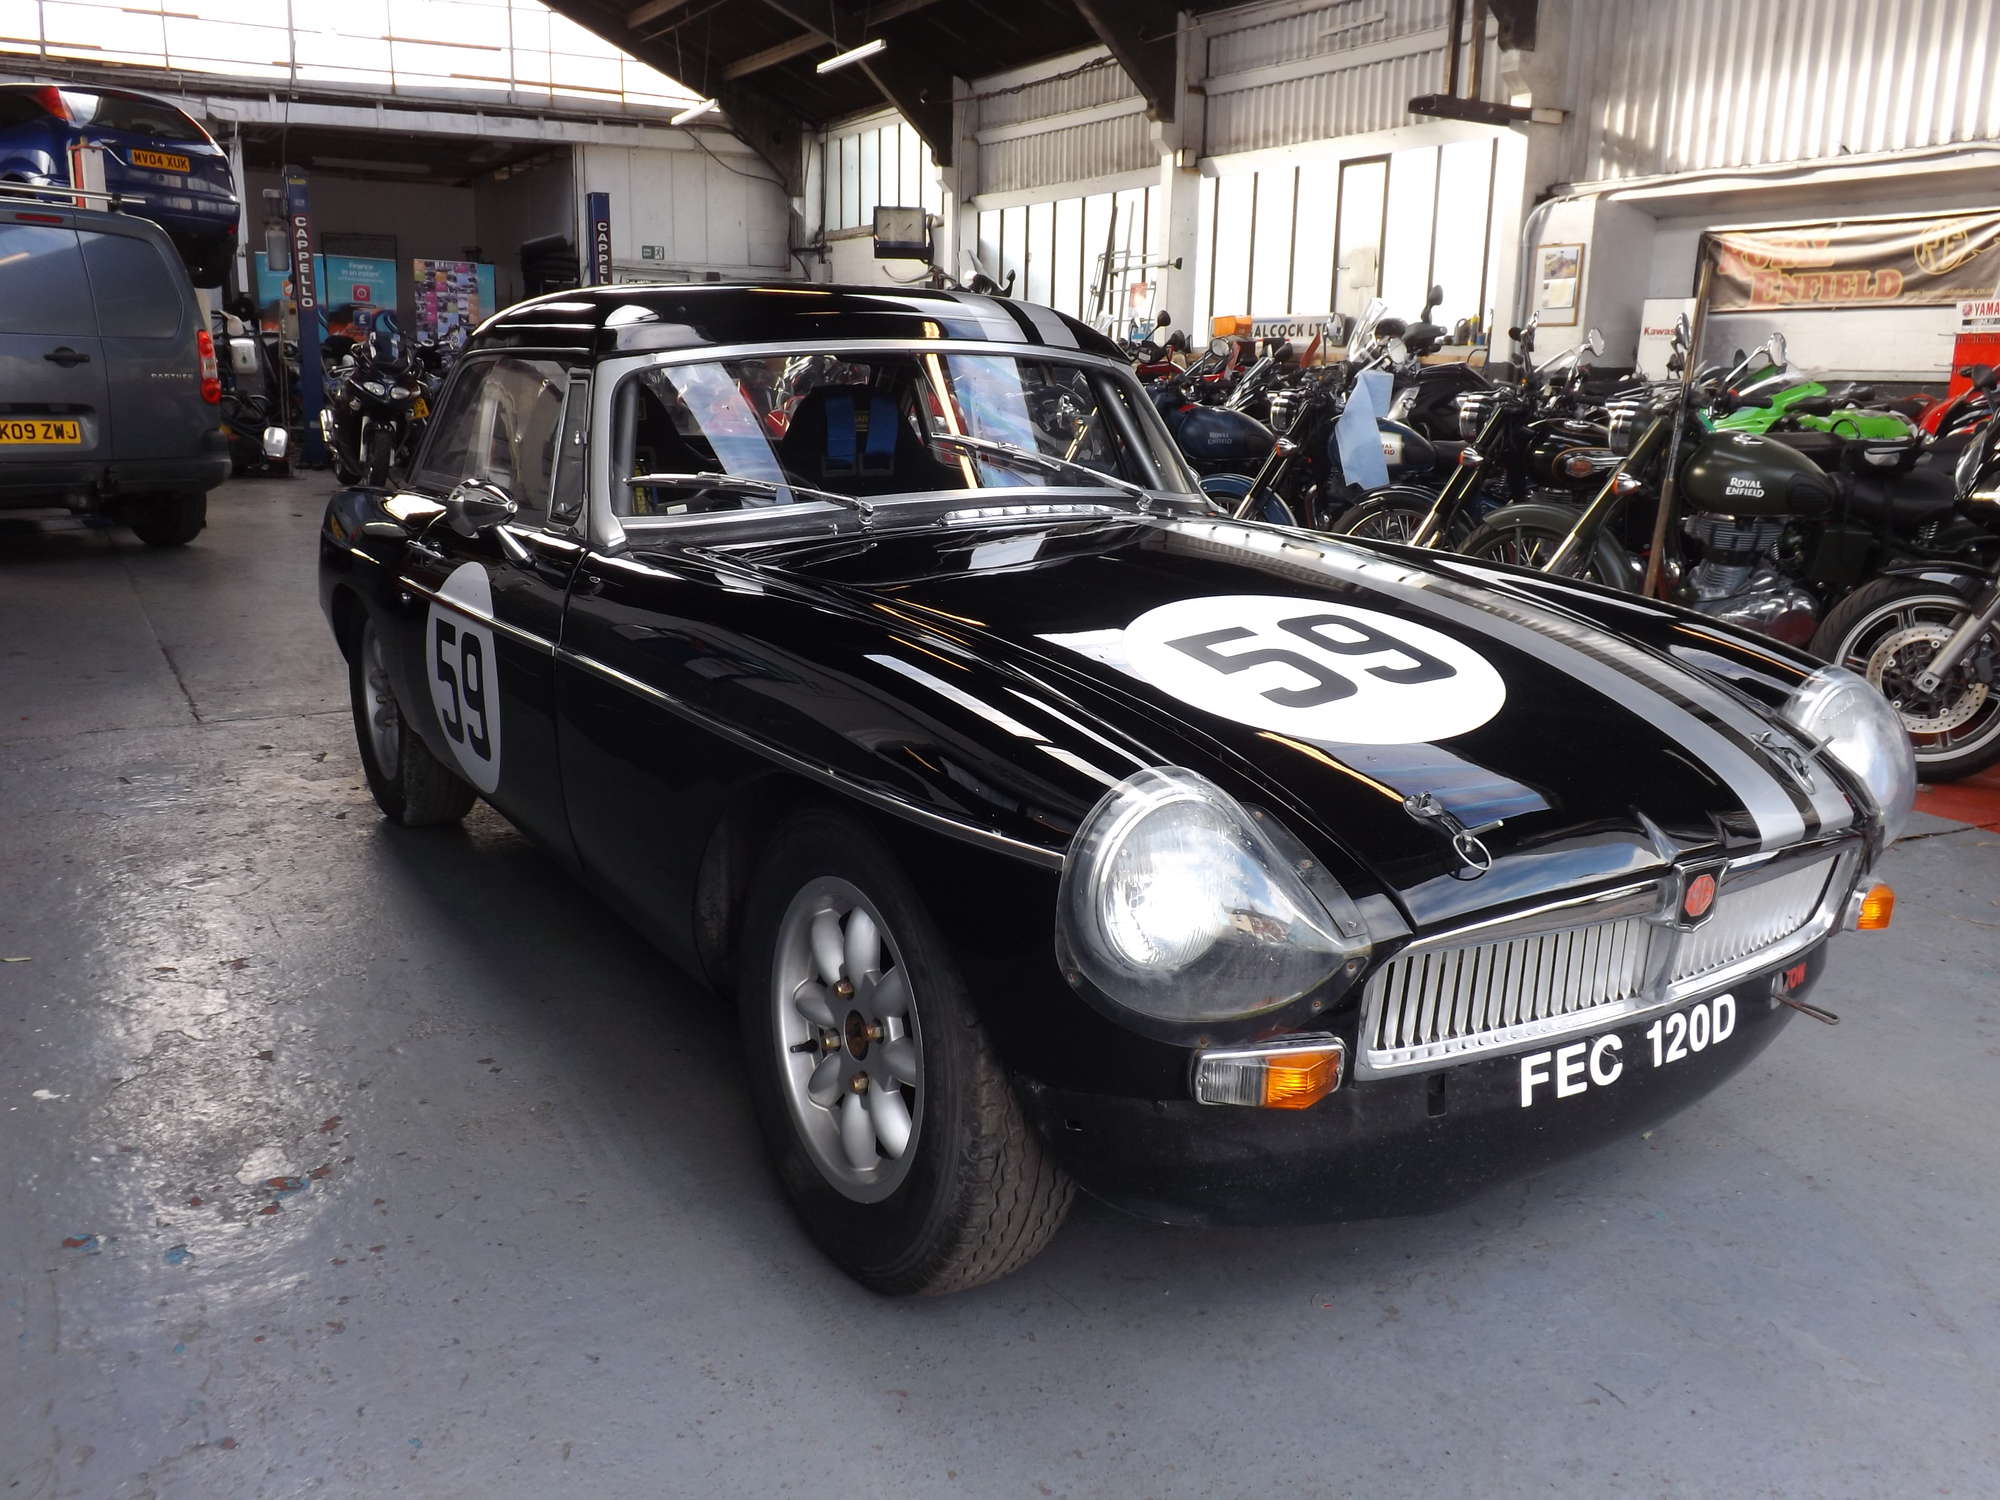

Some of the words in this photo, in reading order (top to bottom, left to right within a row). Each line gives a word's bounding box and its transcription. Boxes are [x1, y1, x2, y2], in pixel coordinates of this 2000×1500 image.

[166, 156, 188, 169] XUK
[294, 216, 314, 308] CAPPELLO
[597, 222, 609, 285] CAPPEL
[1750, 269, 1904, 304] ENFIELD
[1253, 323, 1304, 338] ALCOCK
[1643, 327, 1677, 336] Kawas
[0, 423, 36, 440] K09
[40, 423, 77, 440] ZWJ
[1725, 486, 1765, 498] ENFIELD
[1730, 477, 1761, 488] ROYAL
[1163, 613, 1458, 708] 59
[435, 617, 492, 762] 59
[1520, 1033, 1624, 1108] FEC
[1646, 993, 1736, 1068] 120D
